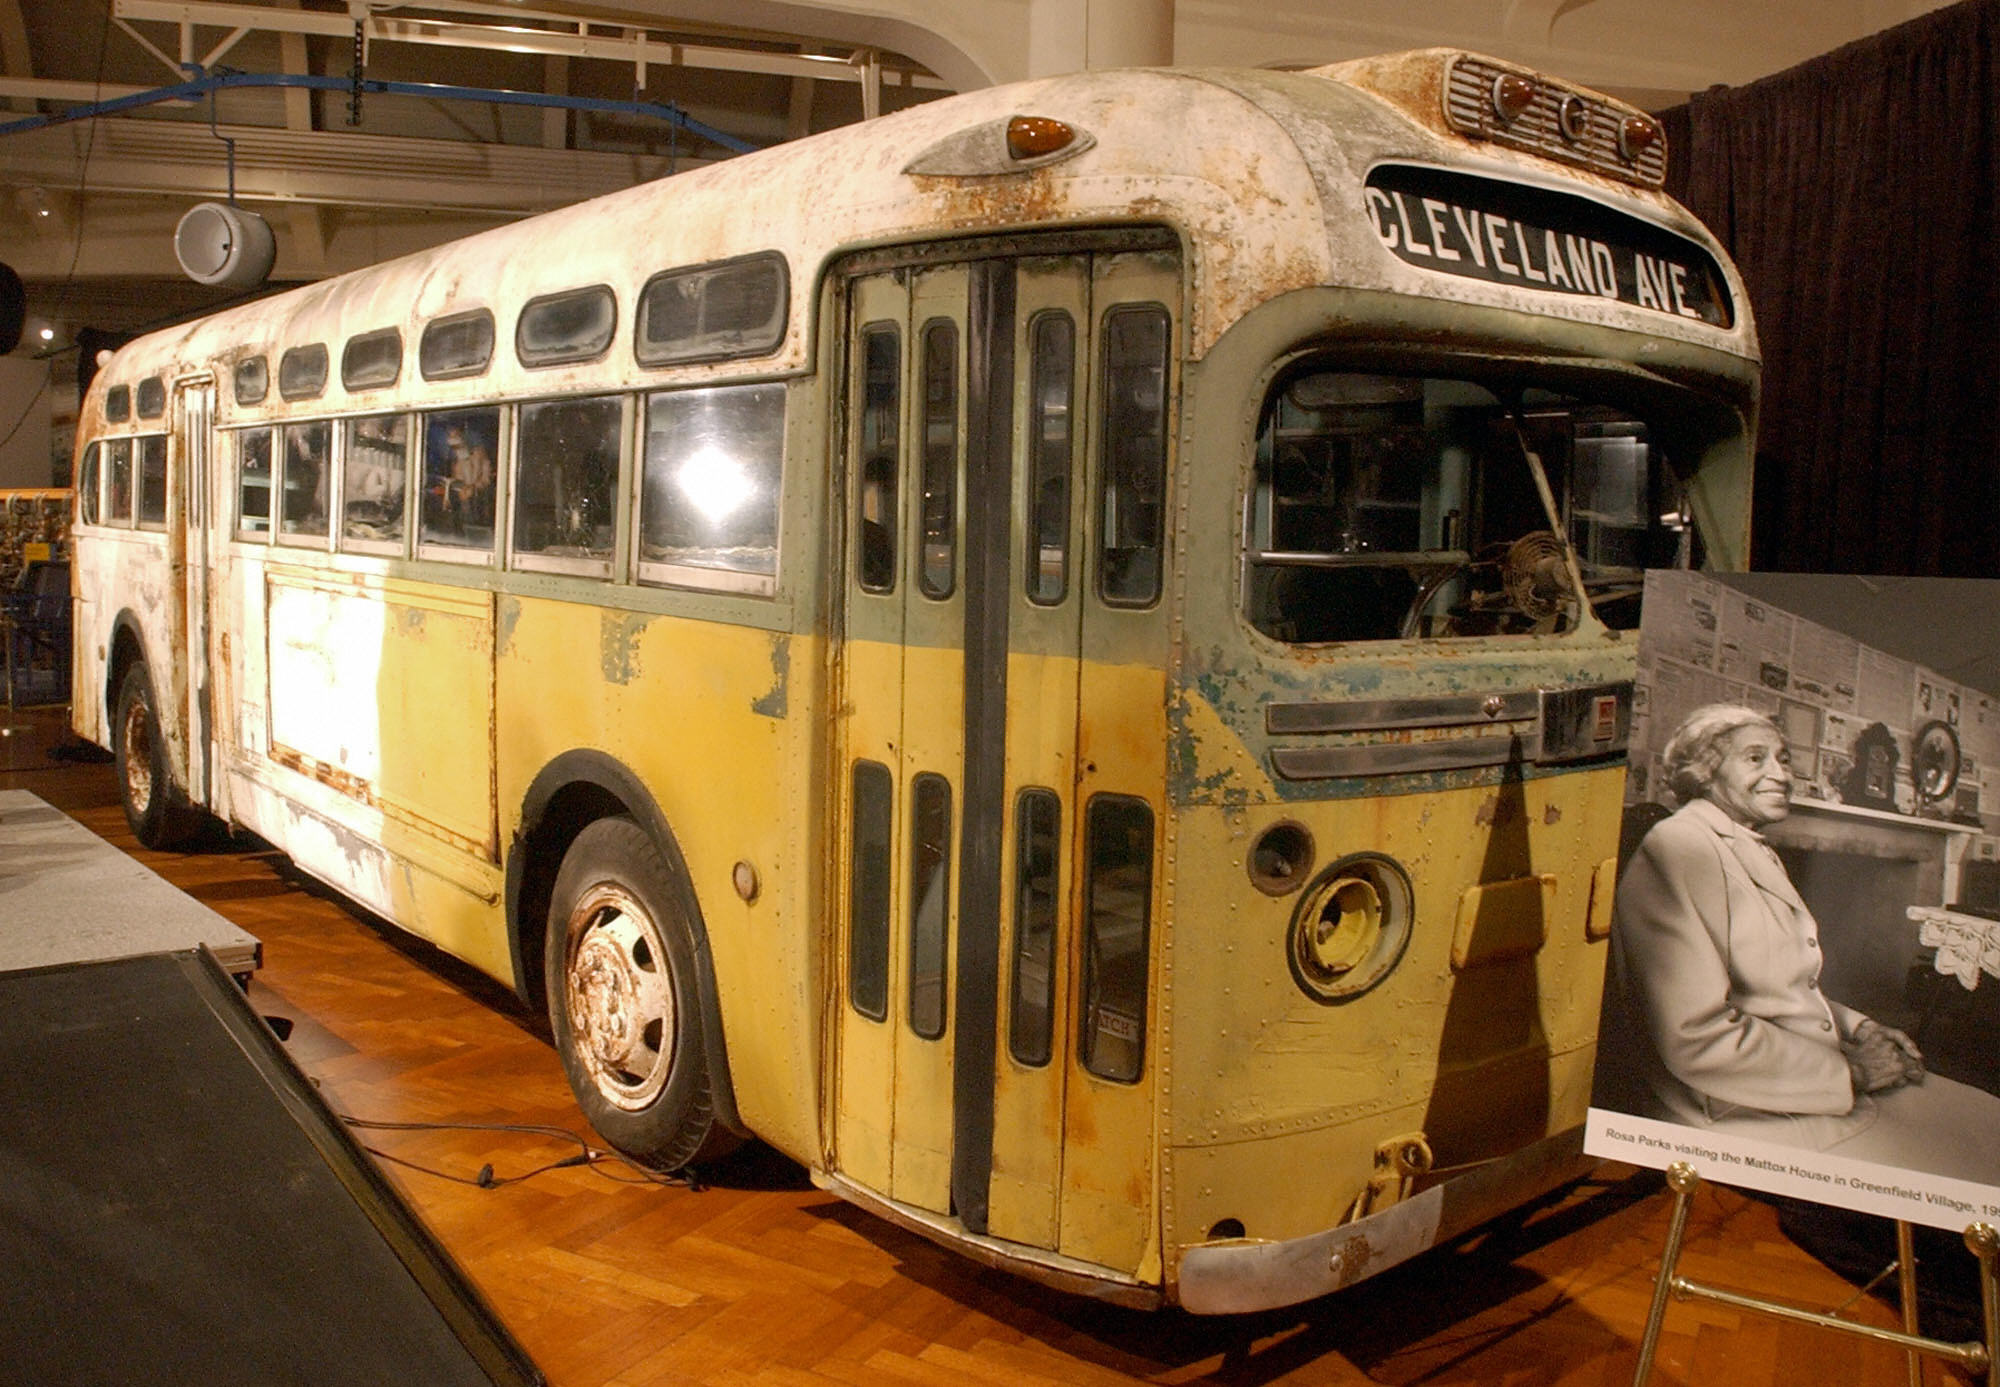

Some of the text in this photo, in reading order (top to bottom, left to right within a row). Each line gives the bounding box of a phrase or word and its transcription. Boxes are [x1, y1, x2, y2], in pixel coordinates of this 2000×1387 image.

[1365, 186, 1618, 299] CLEVELAND
[1606, 1127, 1635, 1143] Rosa
[1638, 1134, 1671, 1151] Parks
[1674, 1144, 1718, 1162] visiting
[1721, 1152, 1742, 1165] the
[1744, 1157, 1786, 1174] Mattox
[1789, 1165, 1831, 1183] House
[1834, 1174, 1847, 1186] in
[1850, 1177, 1922, 1201] Greenfield
